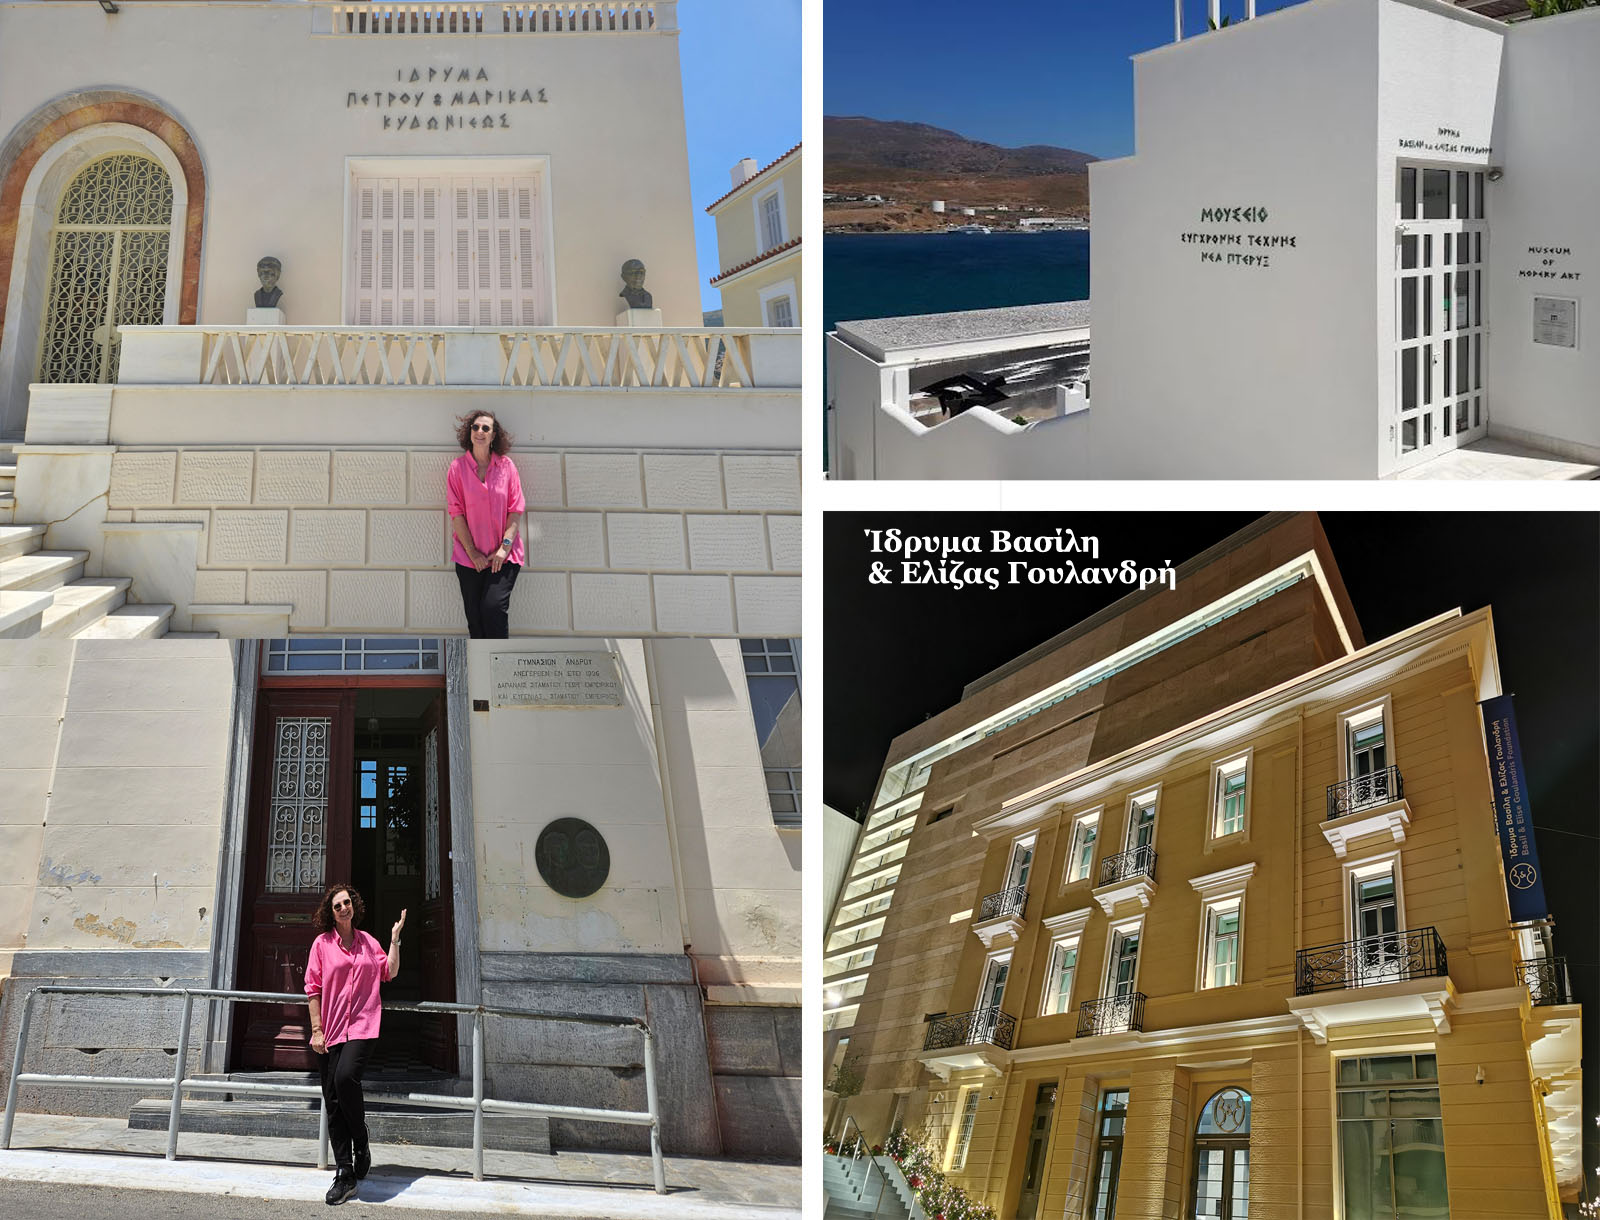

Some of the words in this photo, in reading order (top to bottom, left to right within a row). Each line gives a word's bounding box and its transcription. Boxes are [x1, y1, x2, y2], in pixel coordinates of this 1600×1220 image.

[398, 67, 488, 83] ΙΔΡΥΜΑ
[347, 92, 424, 108] ΠΕΤΡΟΥ
[450, 88, 549, 107] ΜΑΡΙΚΑΣ
[383, 113, 510, 131] ΚΥΔΩΝΙΕΩΣ
[1201, 206, 1268, 223] ΜΟΥΣΕΙΟ
[1181, 233, 1242, 245] ΣΥΓΧΡΟΝΗΣ
[1247, 234, 1297, 248] ΤΕΧΝΗΣ
[1201, 251, 1222, 263] ΝΕΑ
[1227, 253, 1269, 267] ΠΤΕΡΥΞ
[1528, 246, 1572, 255] MUSEUM
[1560, 272, 1581, 280] ART
[517, 658, 557, 666] ΓΥΜΝΑΣΙΟΝ
[565, 658, 592, 666] ΑΝΔΡΟΥ
[1502, 717, 1513, 760] Foundation
[1508, 761, 1520, 803] Goulandris
[1516, 805, 1524, 825] Elise
[1519, 835, 1529, 856] Basil
